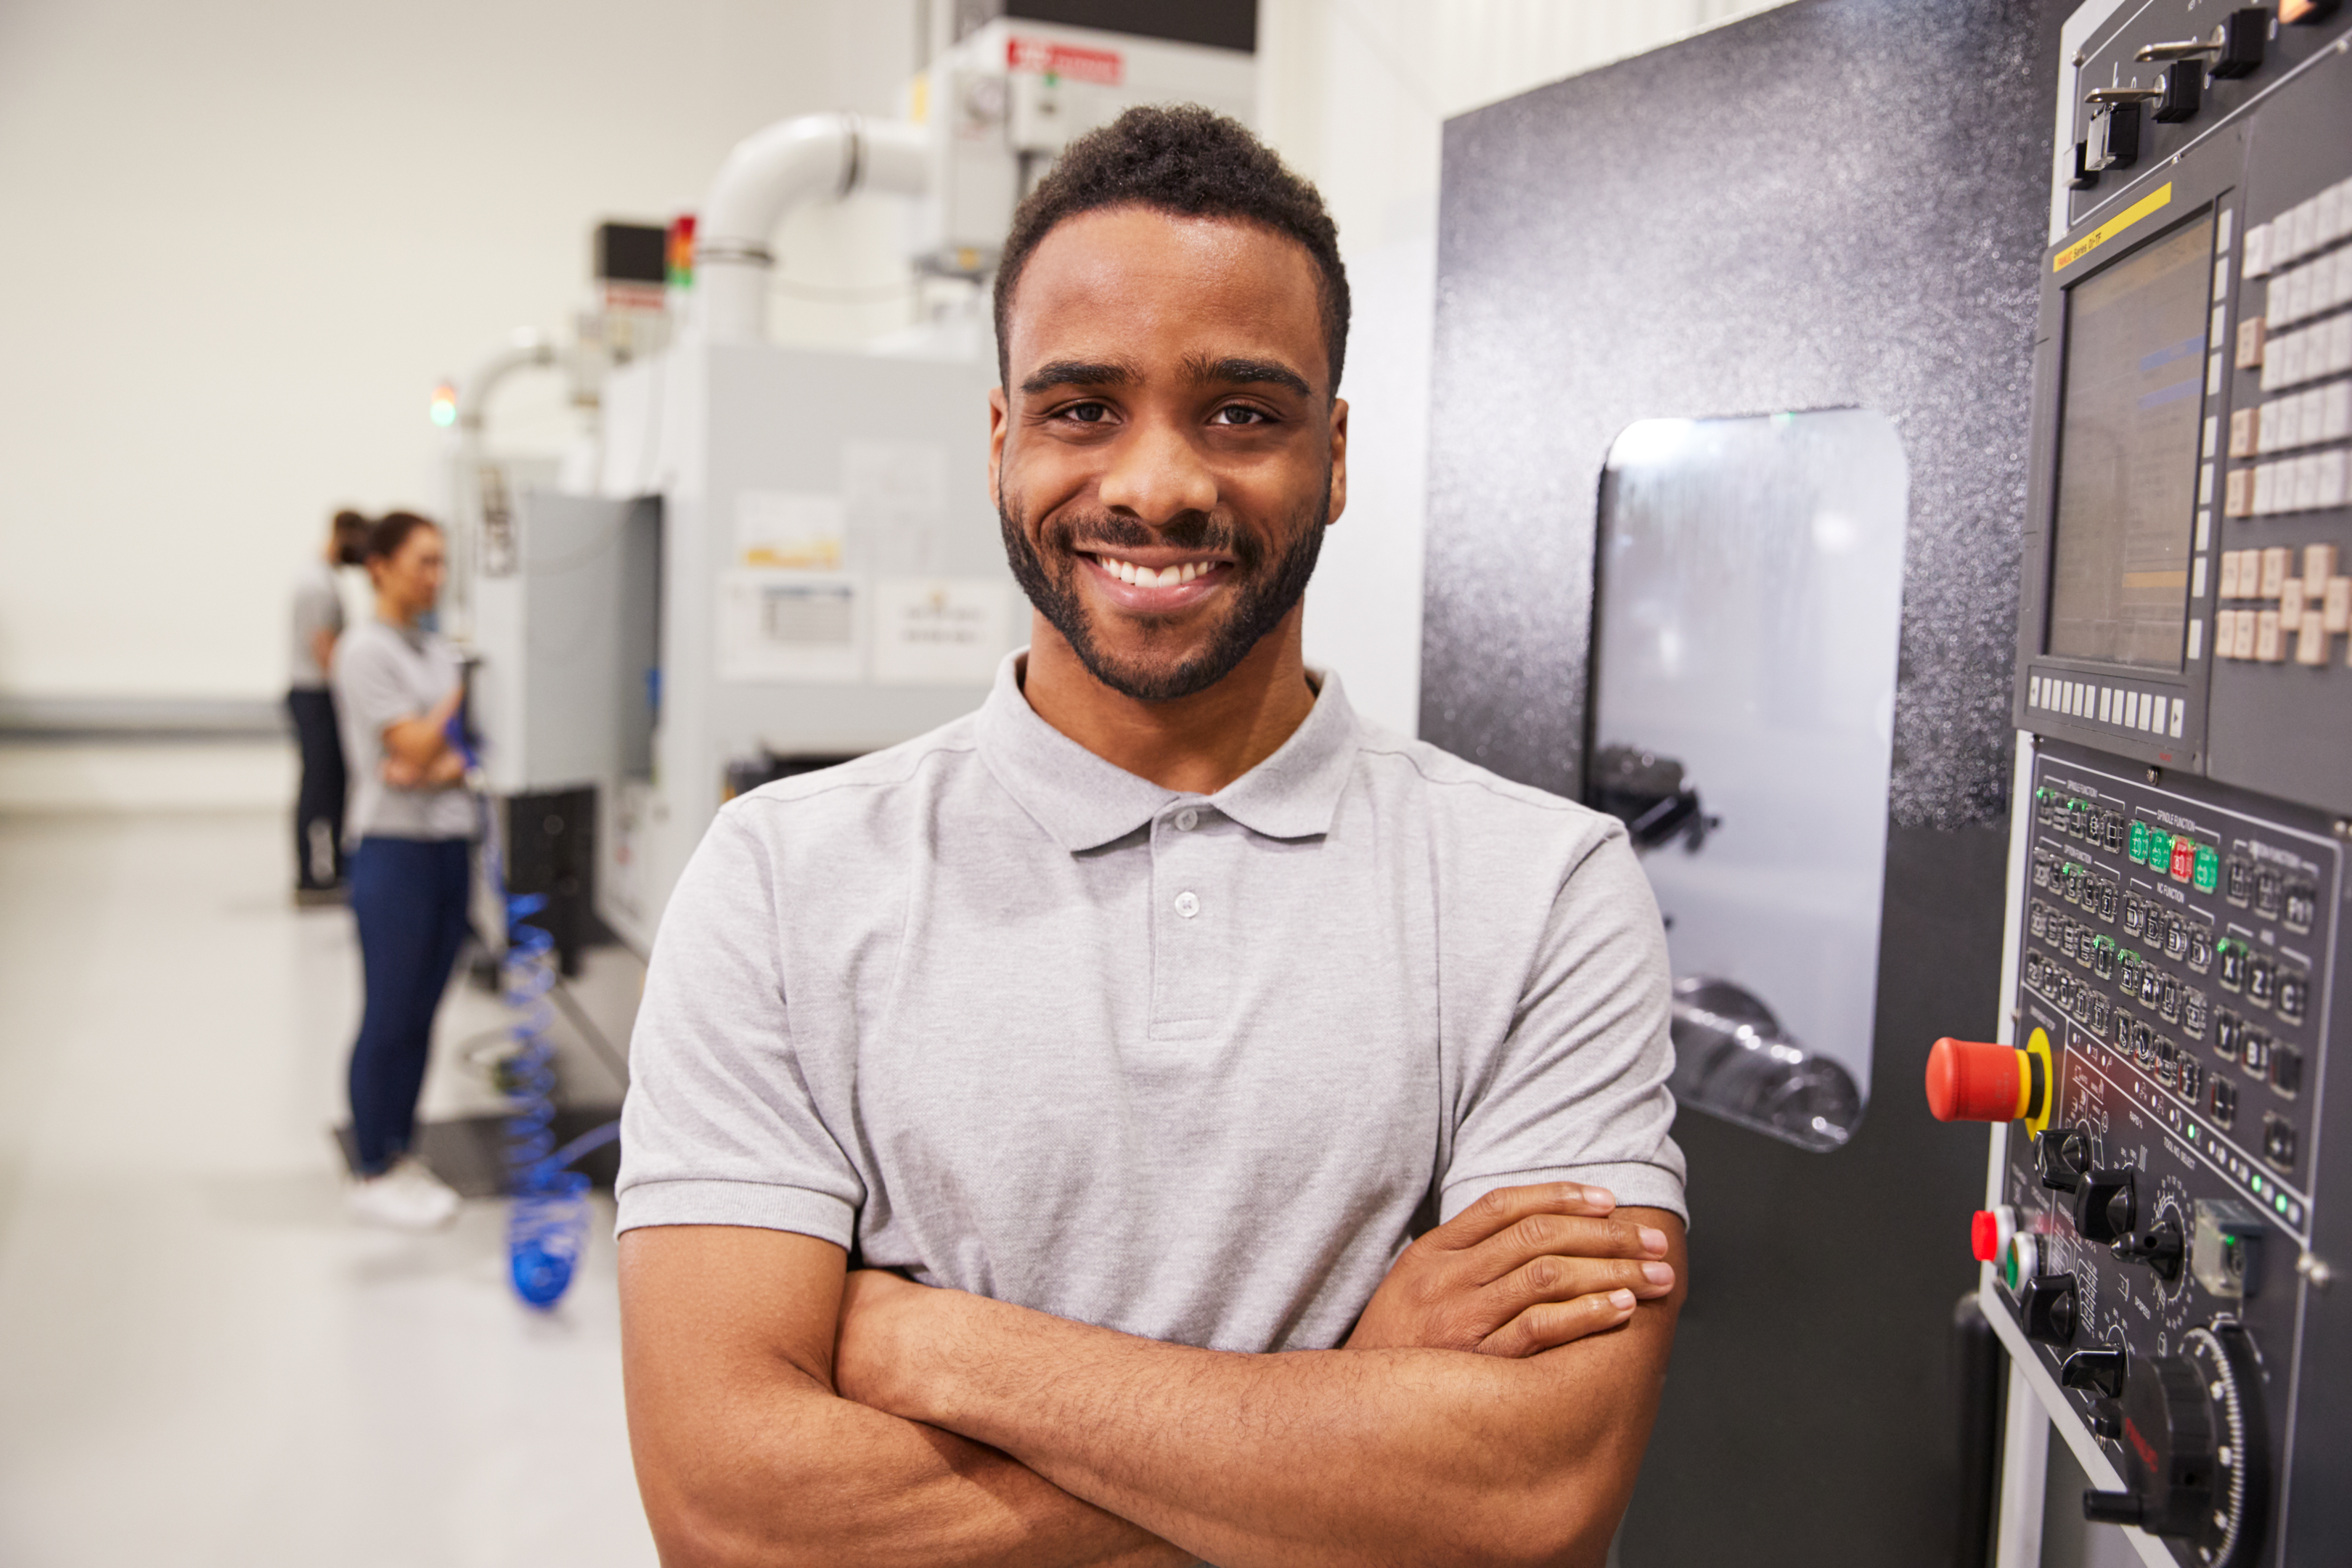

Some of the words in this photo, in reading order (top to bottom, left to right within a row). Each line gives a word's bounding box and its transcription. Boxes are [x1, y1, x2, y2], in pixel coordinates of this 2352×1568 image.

[2073, 245, 2088, 259] Series
[2157, 809, 2173, 825] SPINDLE
[2173, 813, 2195, 832] FUNCTION
[2177, 842, 2186, 852] STOP
[2157, 881, 2165, 894] NC
[2163, 884, 2184, 904] FUNCTION
[2125, 957, 2134, 968] AUTO
[2224, 955, 2234, 979] X
[2252, 969, 2263, 995] Z
[2281, 984, 2295, 1010] C
[2220, 1024, 2229, 1046] Y
[2247, 1040, 2258, 1065] B
[2129, 1111, 2139, 1126] RAPID
[2164, 1136, 2173, 1153] TOOL
[2173, 1145, 2181, 1159] NO
[2180, 1151, 2196, 1170] SELECT
